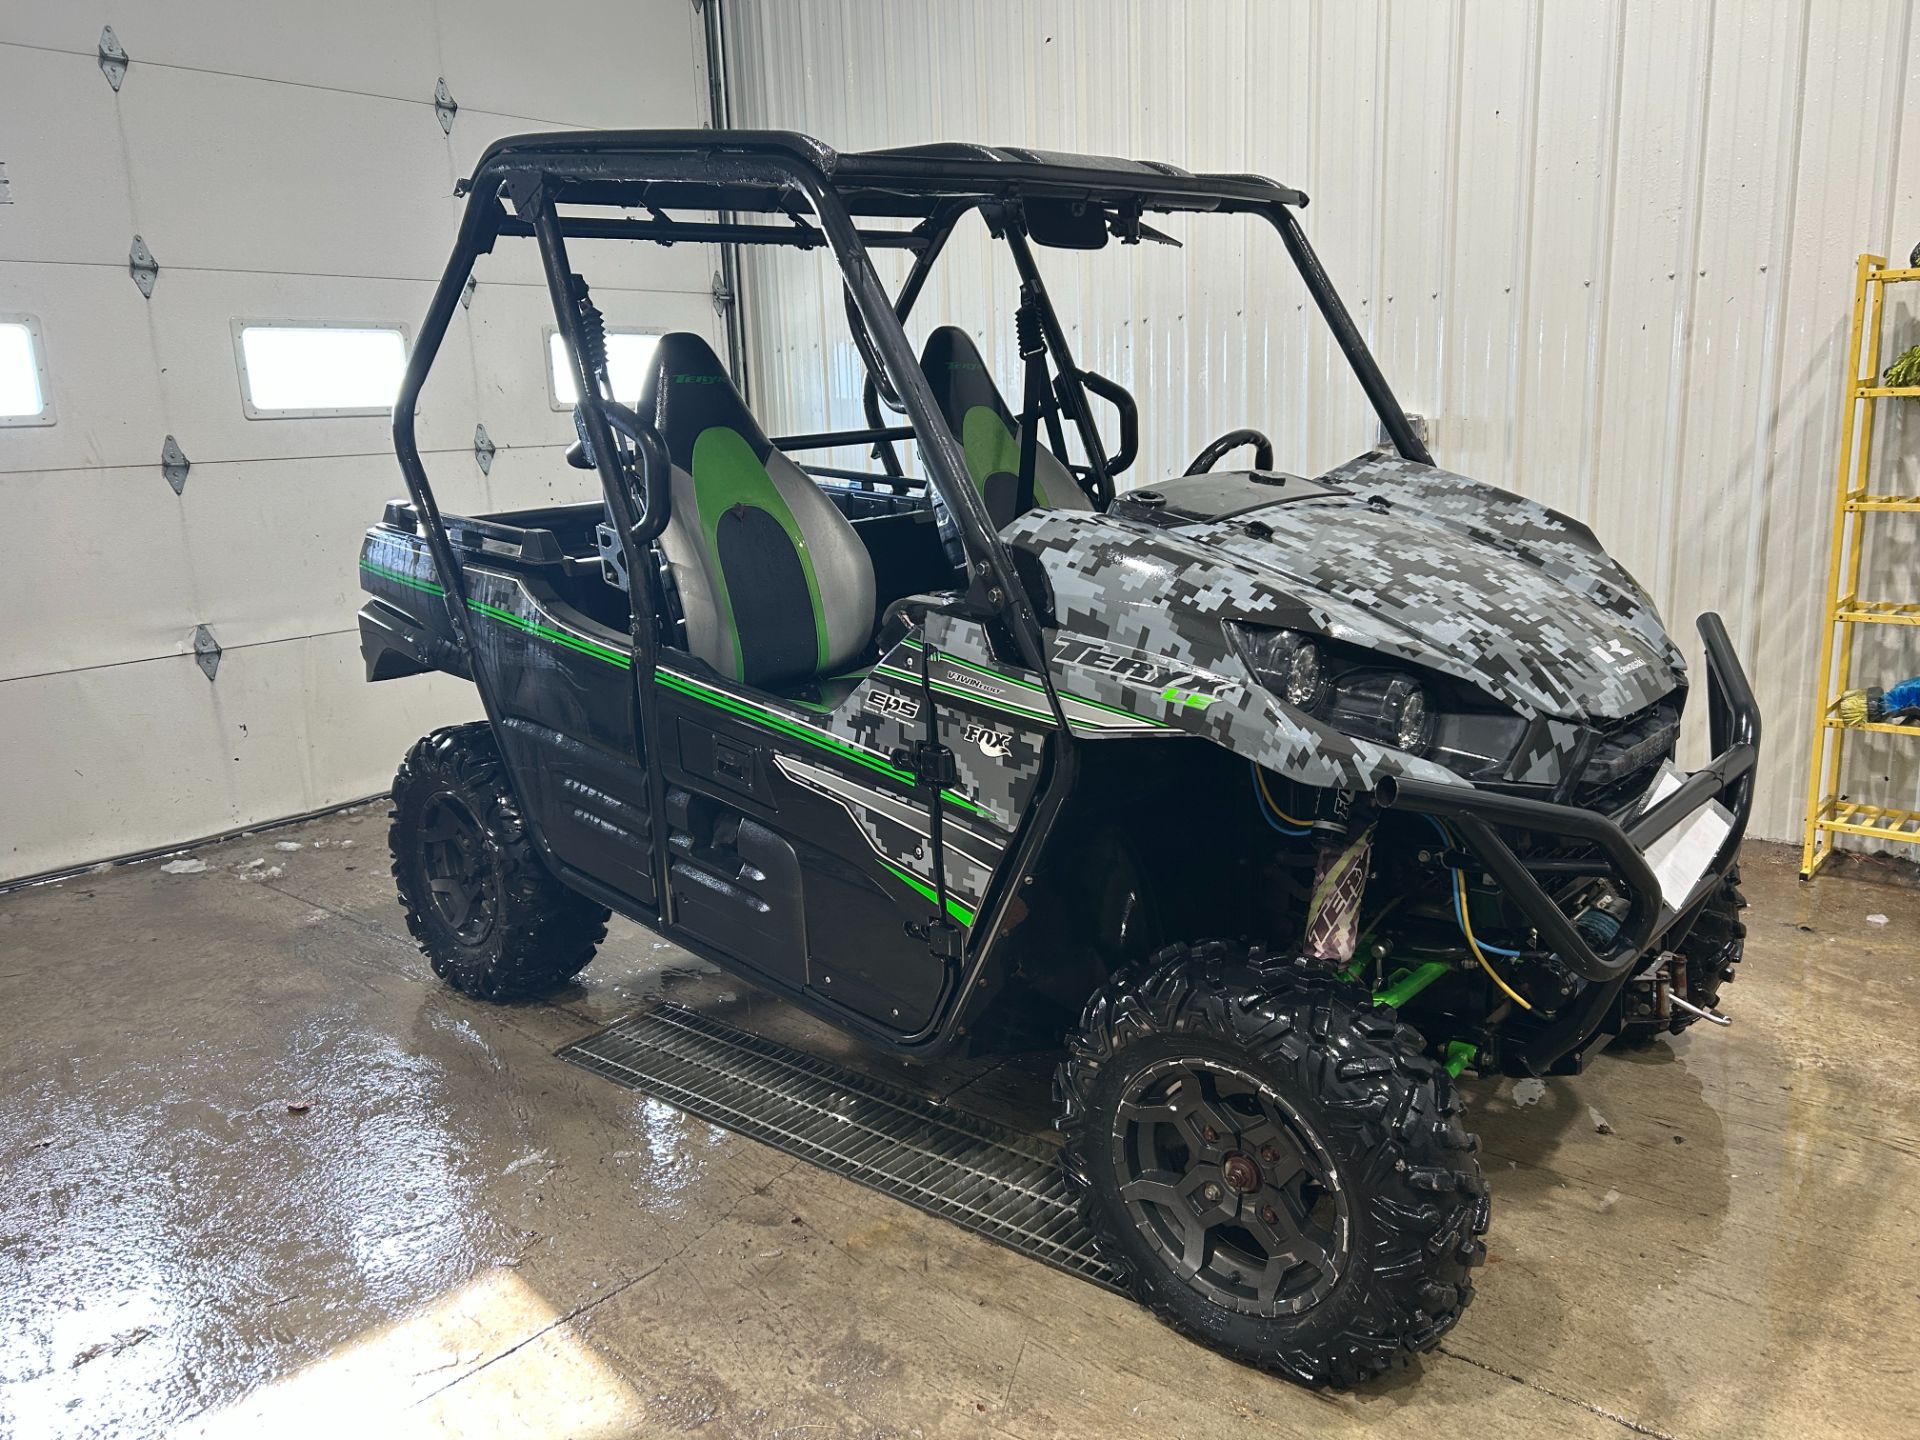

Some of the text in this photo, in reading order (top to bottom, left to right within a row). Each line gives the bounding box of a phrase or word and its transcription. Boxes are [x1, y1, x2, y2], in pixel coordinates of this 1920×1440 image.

[1613, 656, 1647, 675] Kawasaki
[866, 689, 919, 718] EPS
[963, 724, 1013, 750] FOX
